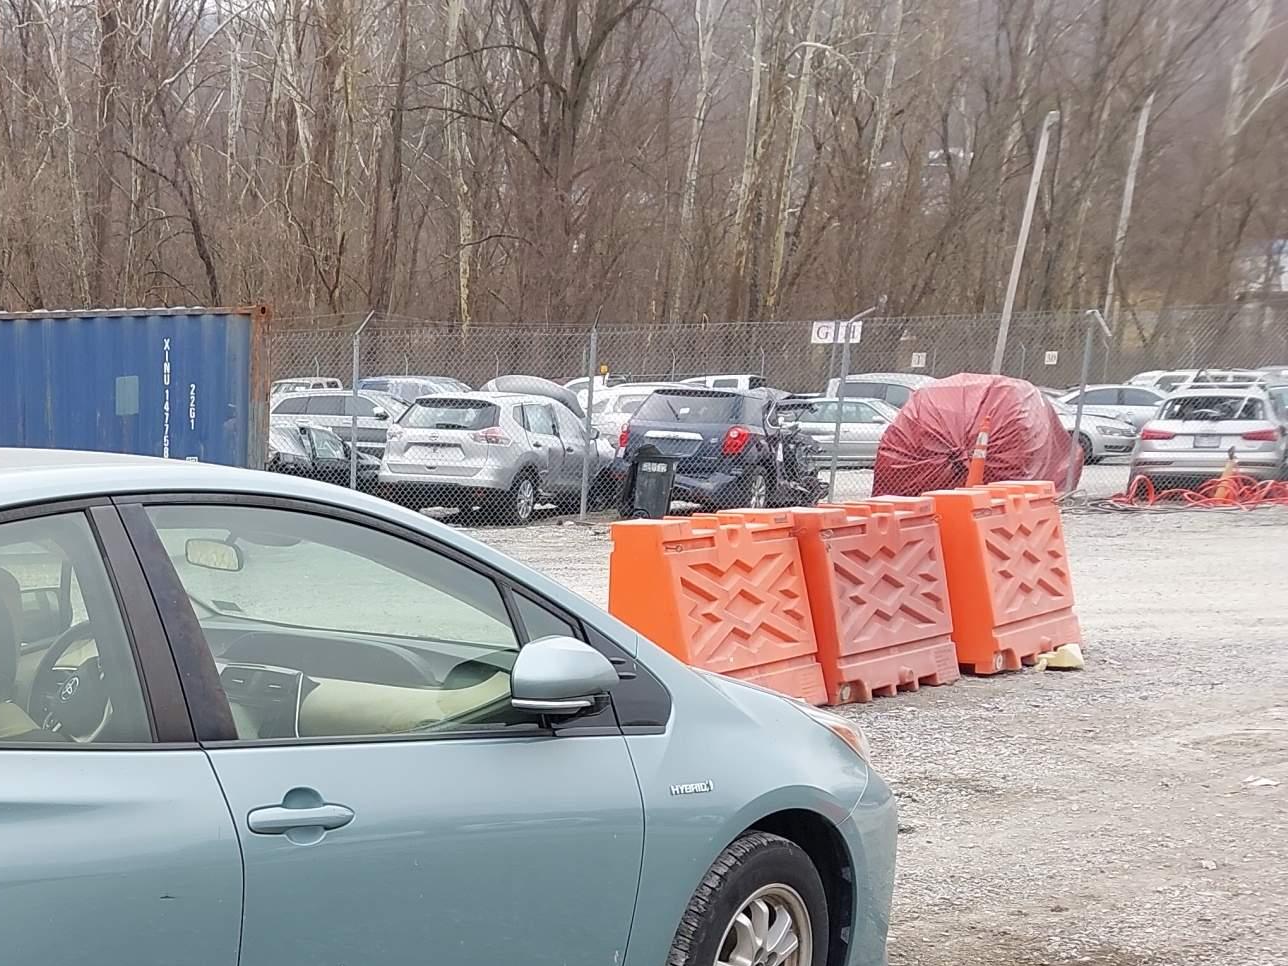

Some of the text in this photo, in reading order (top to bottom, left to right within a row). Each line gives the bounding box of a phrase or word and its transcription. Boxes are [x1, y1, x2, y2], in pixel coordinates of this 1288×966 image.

[816, 324, 830, 340] G
[163, 338, 171, 385] XINU
[670, 782, 706, 796] HYBRID
